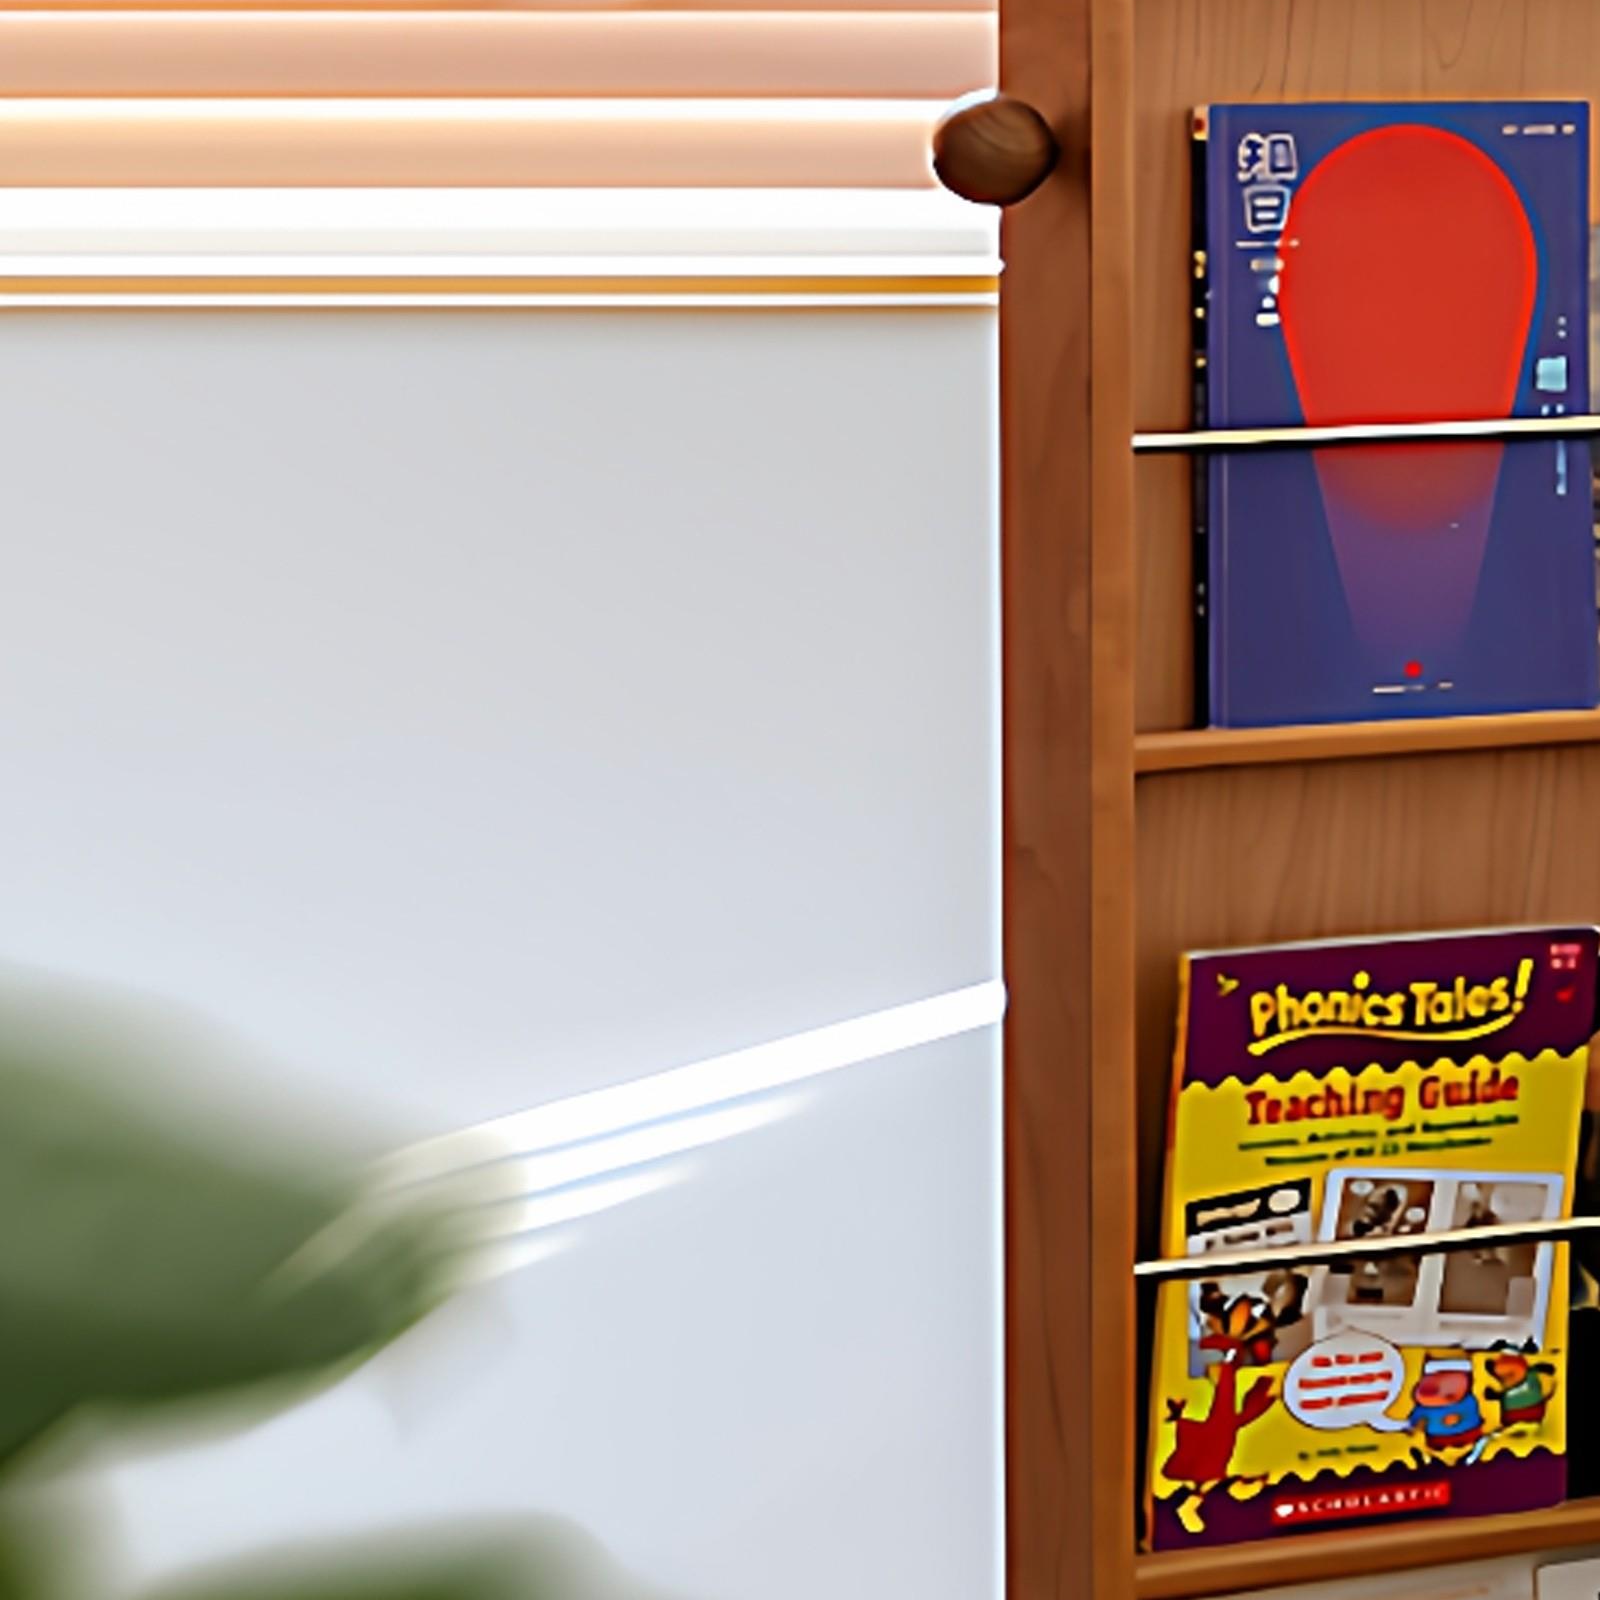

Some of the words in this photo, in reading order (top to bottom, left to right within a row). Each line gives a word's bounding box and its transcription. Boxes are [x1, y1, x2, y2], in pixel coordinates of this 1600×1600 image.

[1250, 971, 1405, 1037] Phonics
[1409, 958, 1534, 1026] Tales!
[1245, 1081, 1405, 1127] Teaching
[1418, 1067, 1519, 1110] Guide
[1298, 1489, 1440, 1513] SCHOLASTIC
